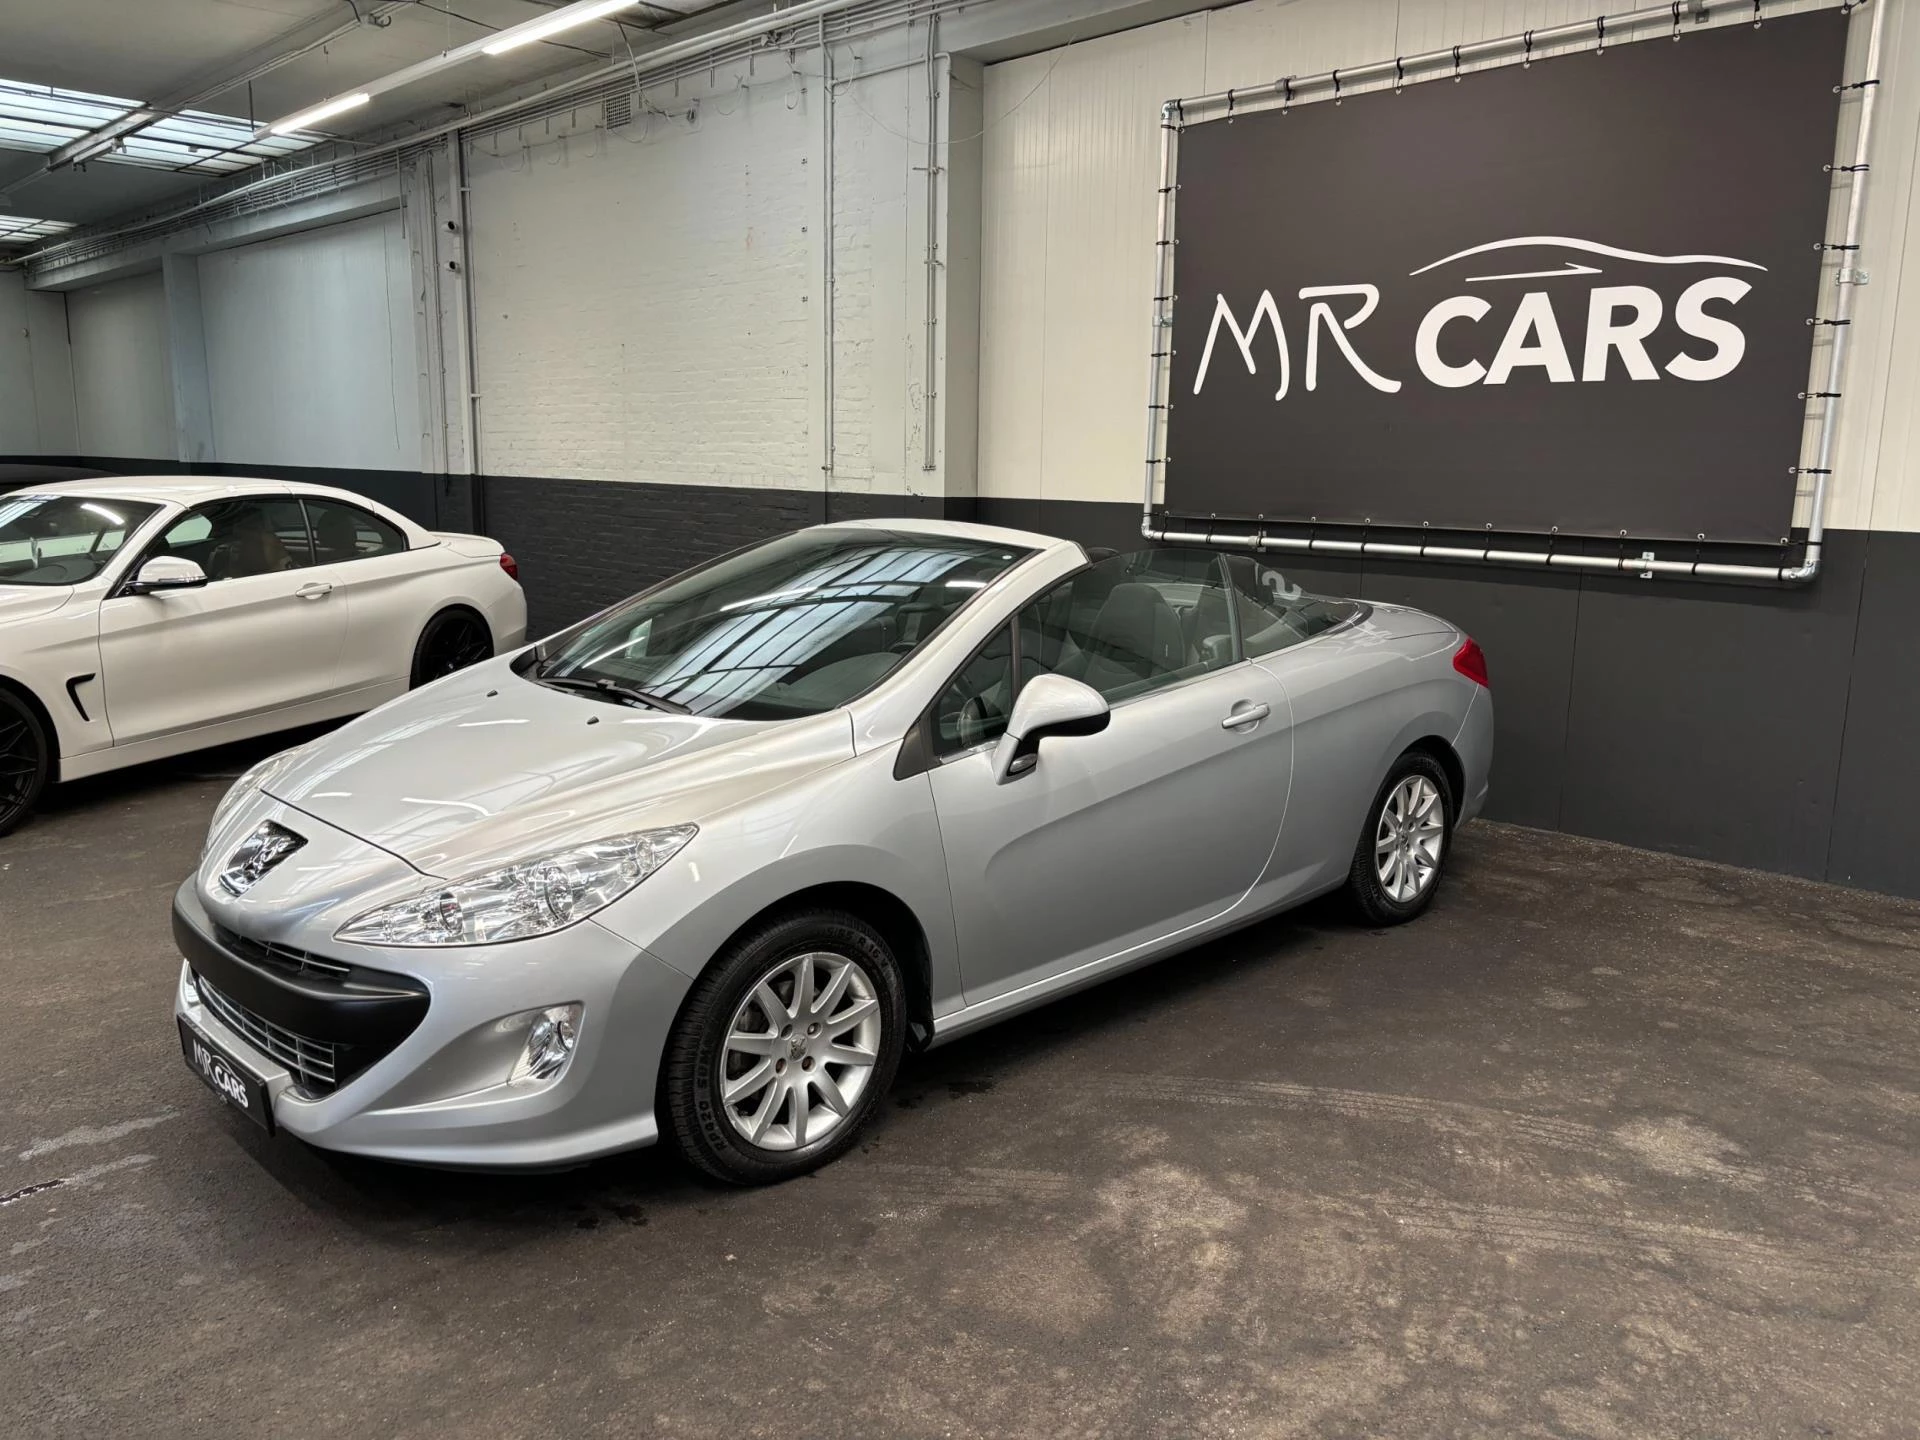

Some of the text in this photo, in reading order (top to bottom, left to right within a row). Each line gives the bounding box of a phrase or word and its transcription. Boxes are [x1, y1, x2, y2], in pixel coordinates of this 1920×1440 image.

[1194, 276, 1752, 401] MR CARS
[193, 1039, 248, 1108] MR CARS
